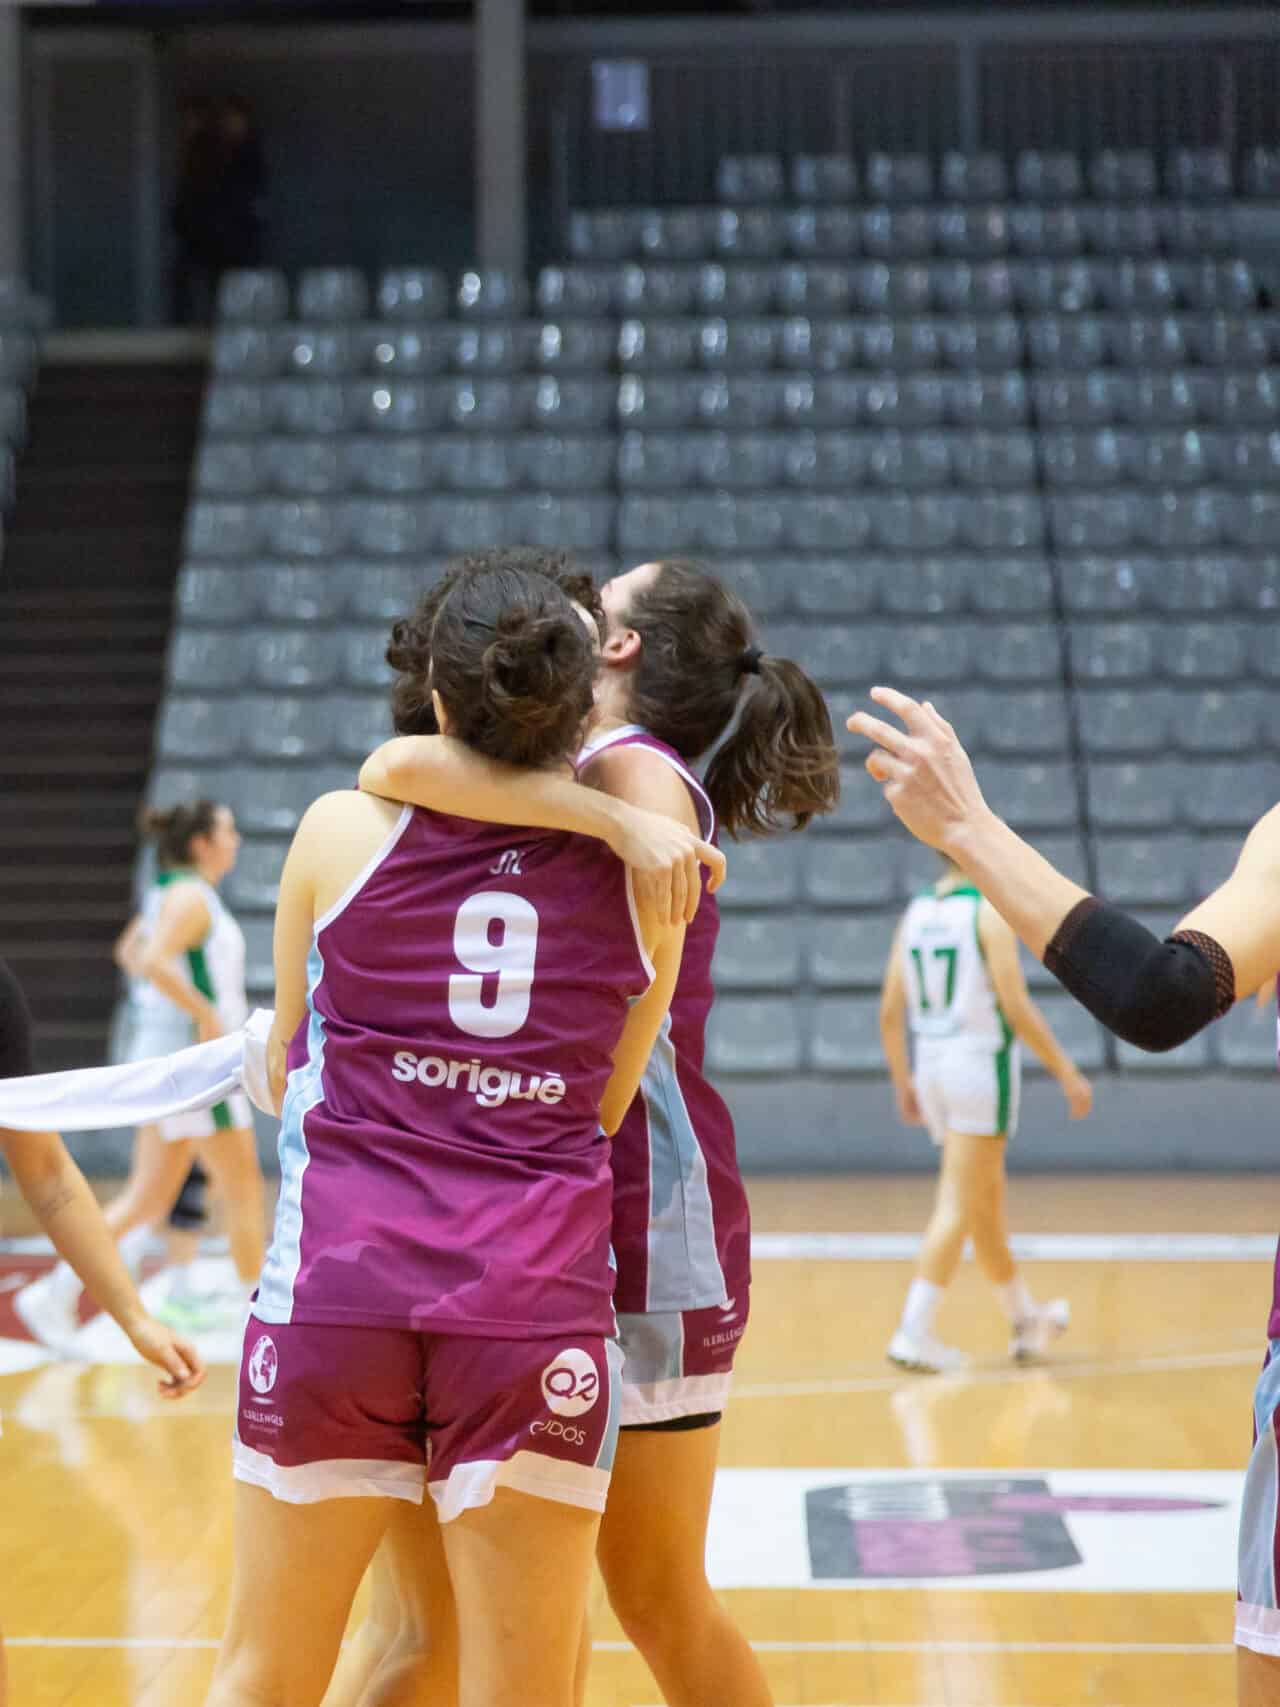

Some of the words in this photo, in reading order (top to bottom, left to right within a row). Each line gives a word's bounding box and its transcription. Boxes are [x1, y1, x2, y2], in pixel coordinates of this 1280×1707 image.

[448, 890, 540, 1039] 9
[910, 946, 958, 1010] 17
[544, 1366, 597, 1402] Q2
